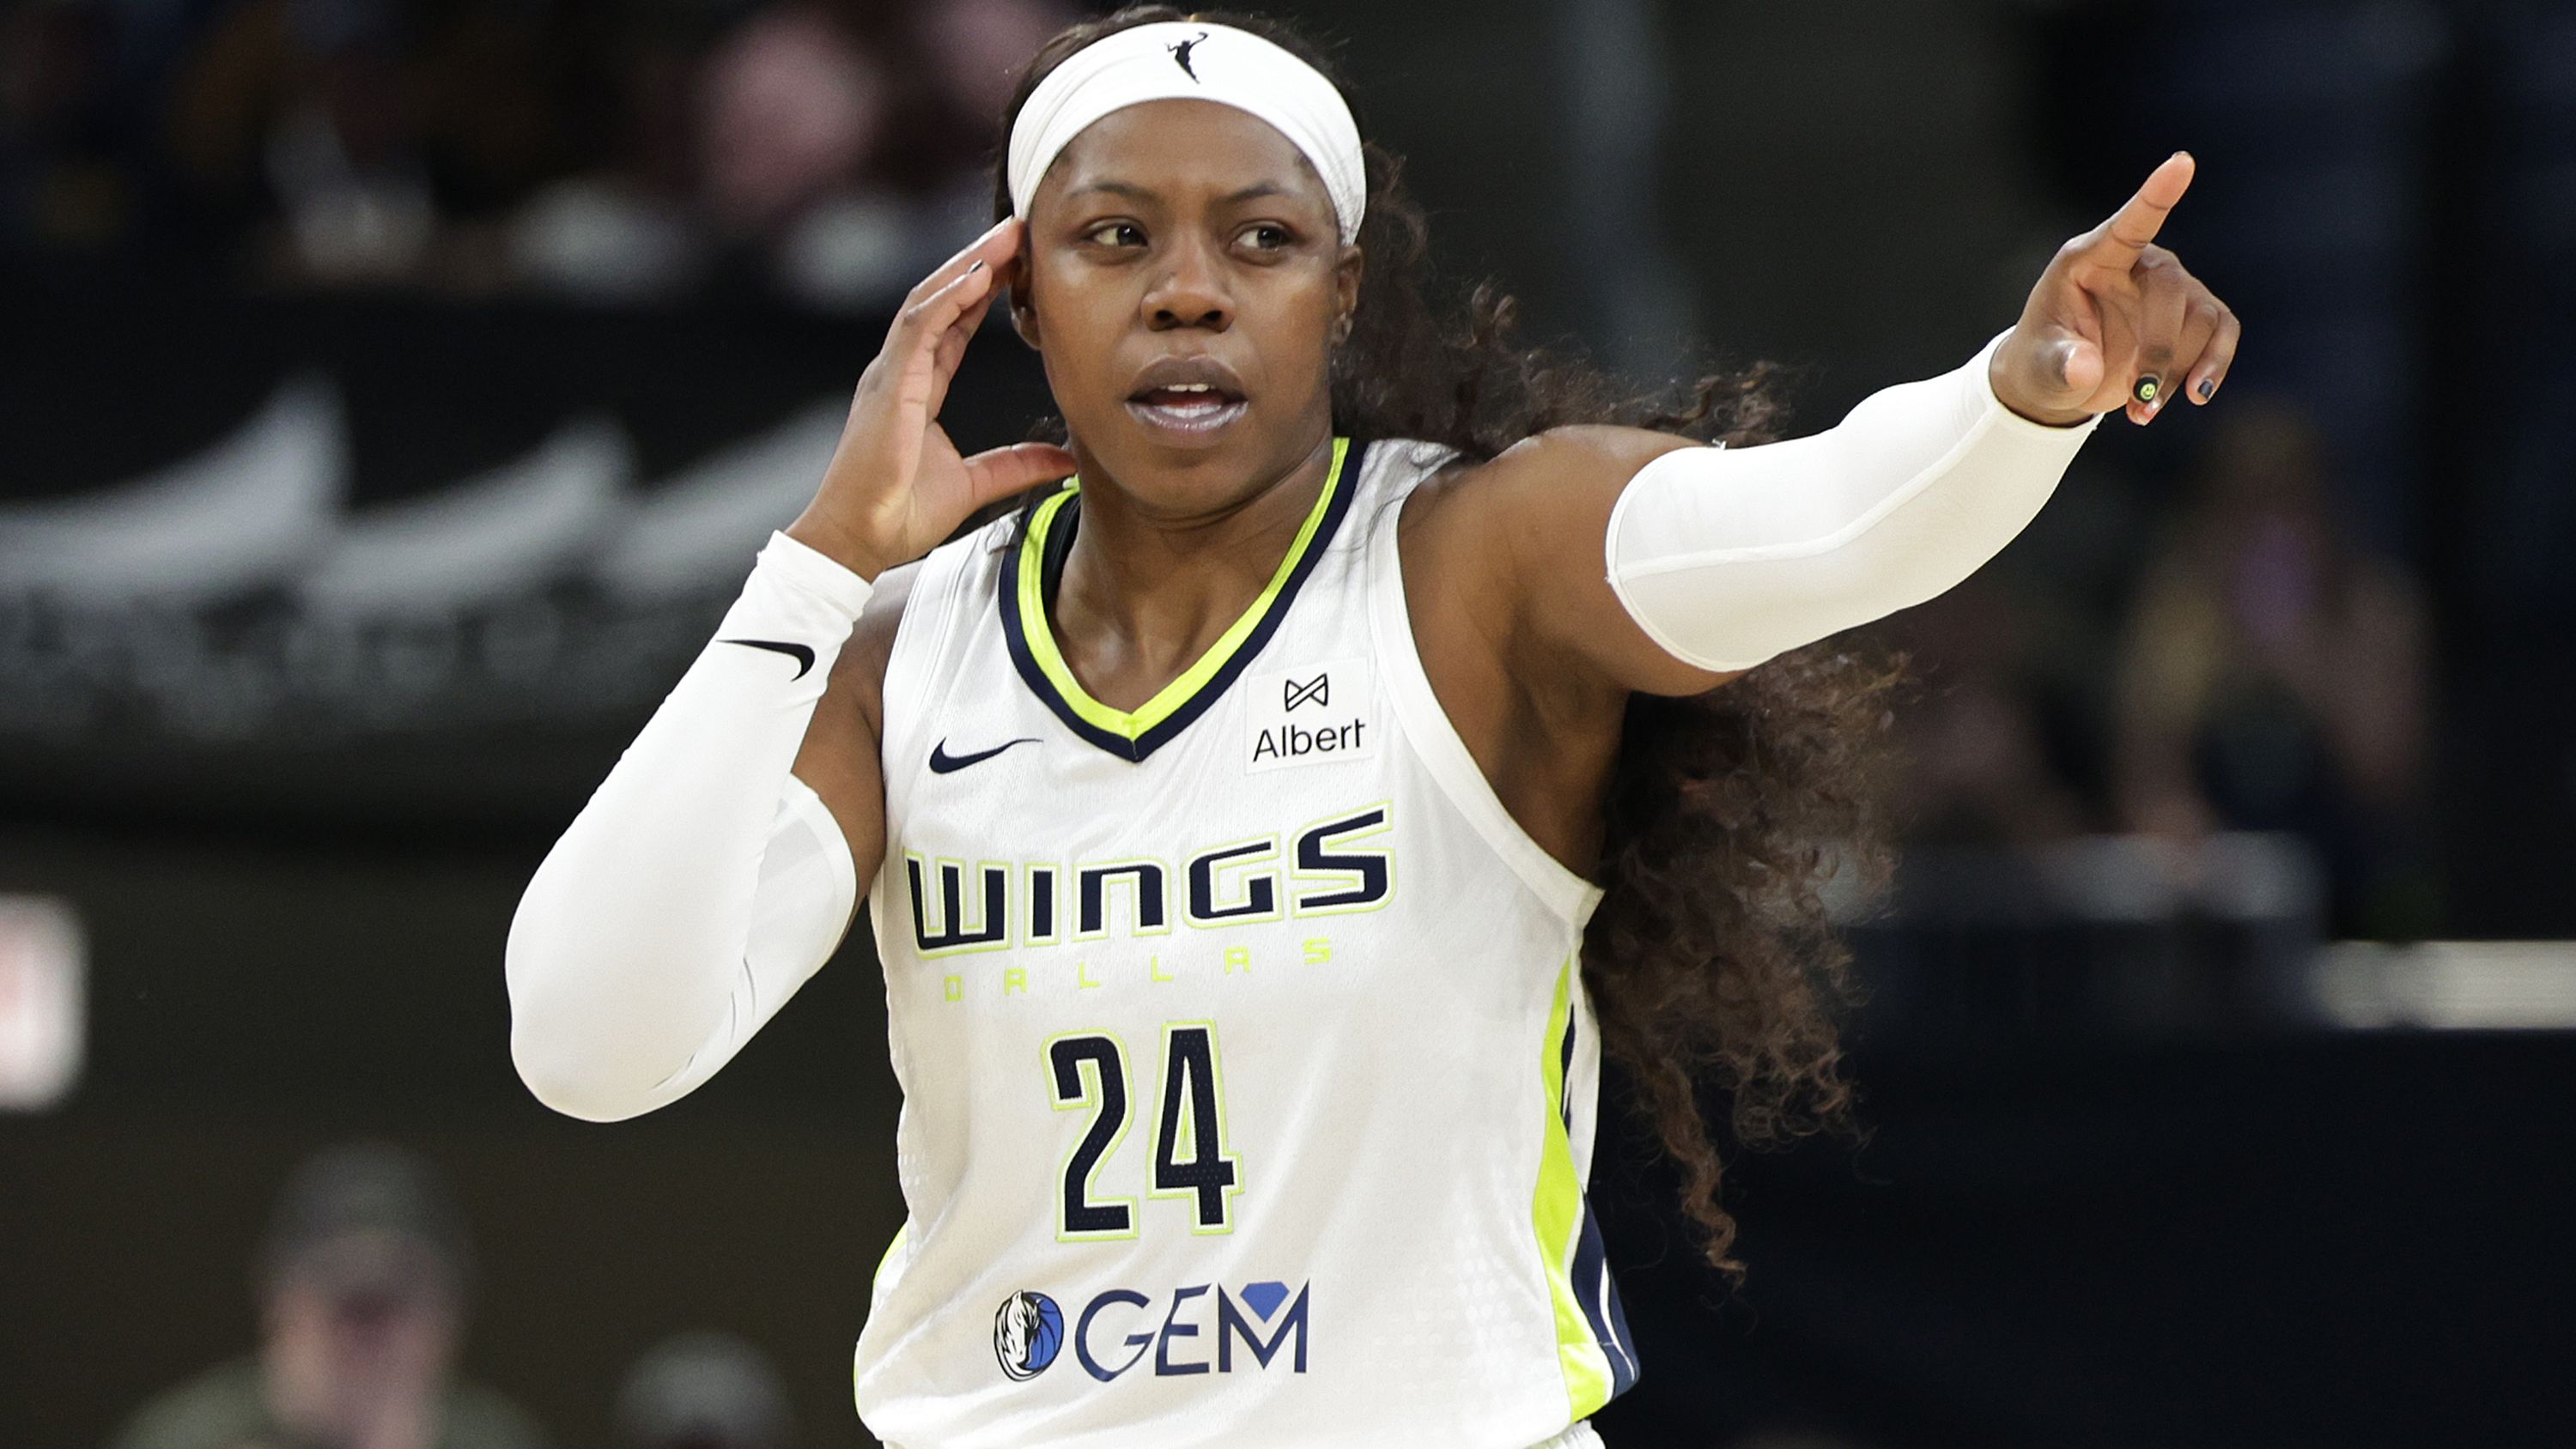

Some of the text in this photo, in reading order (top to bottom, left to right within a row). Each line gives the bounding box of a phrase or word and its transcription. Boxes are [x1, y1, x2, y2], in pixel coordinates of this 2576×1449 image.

[1253, 718, 1366, 762] Albert
[904, 800, 1395, 957] WINGS
[945, 937, 1333, 1002] DALLAS
[1040, 1018, 1244, 1242] 24
[1074, 1278, 1310, 1383] GEM
